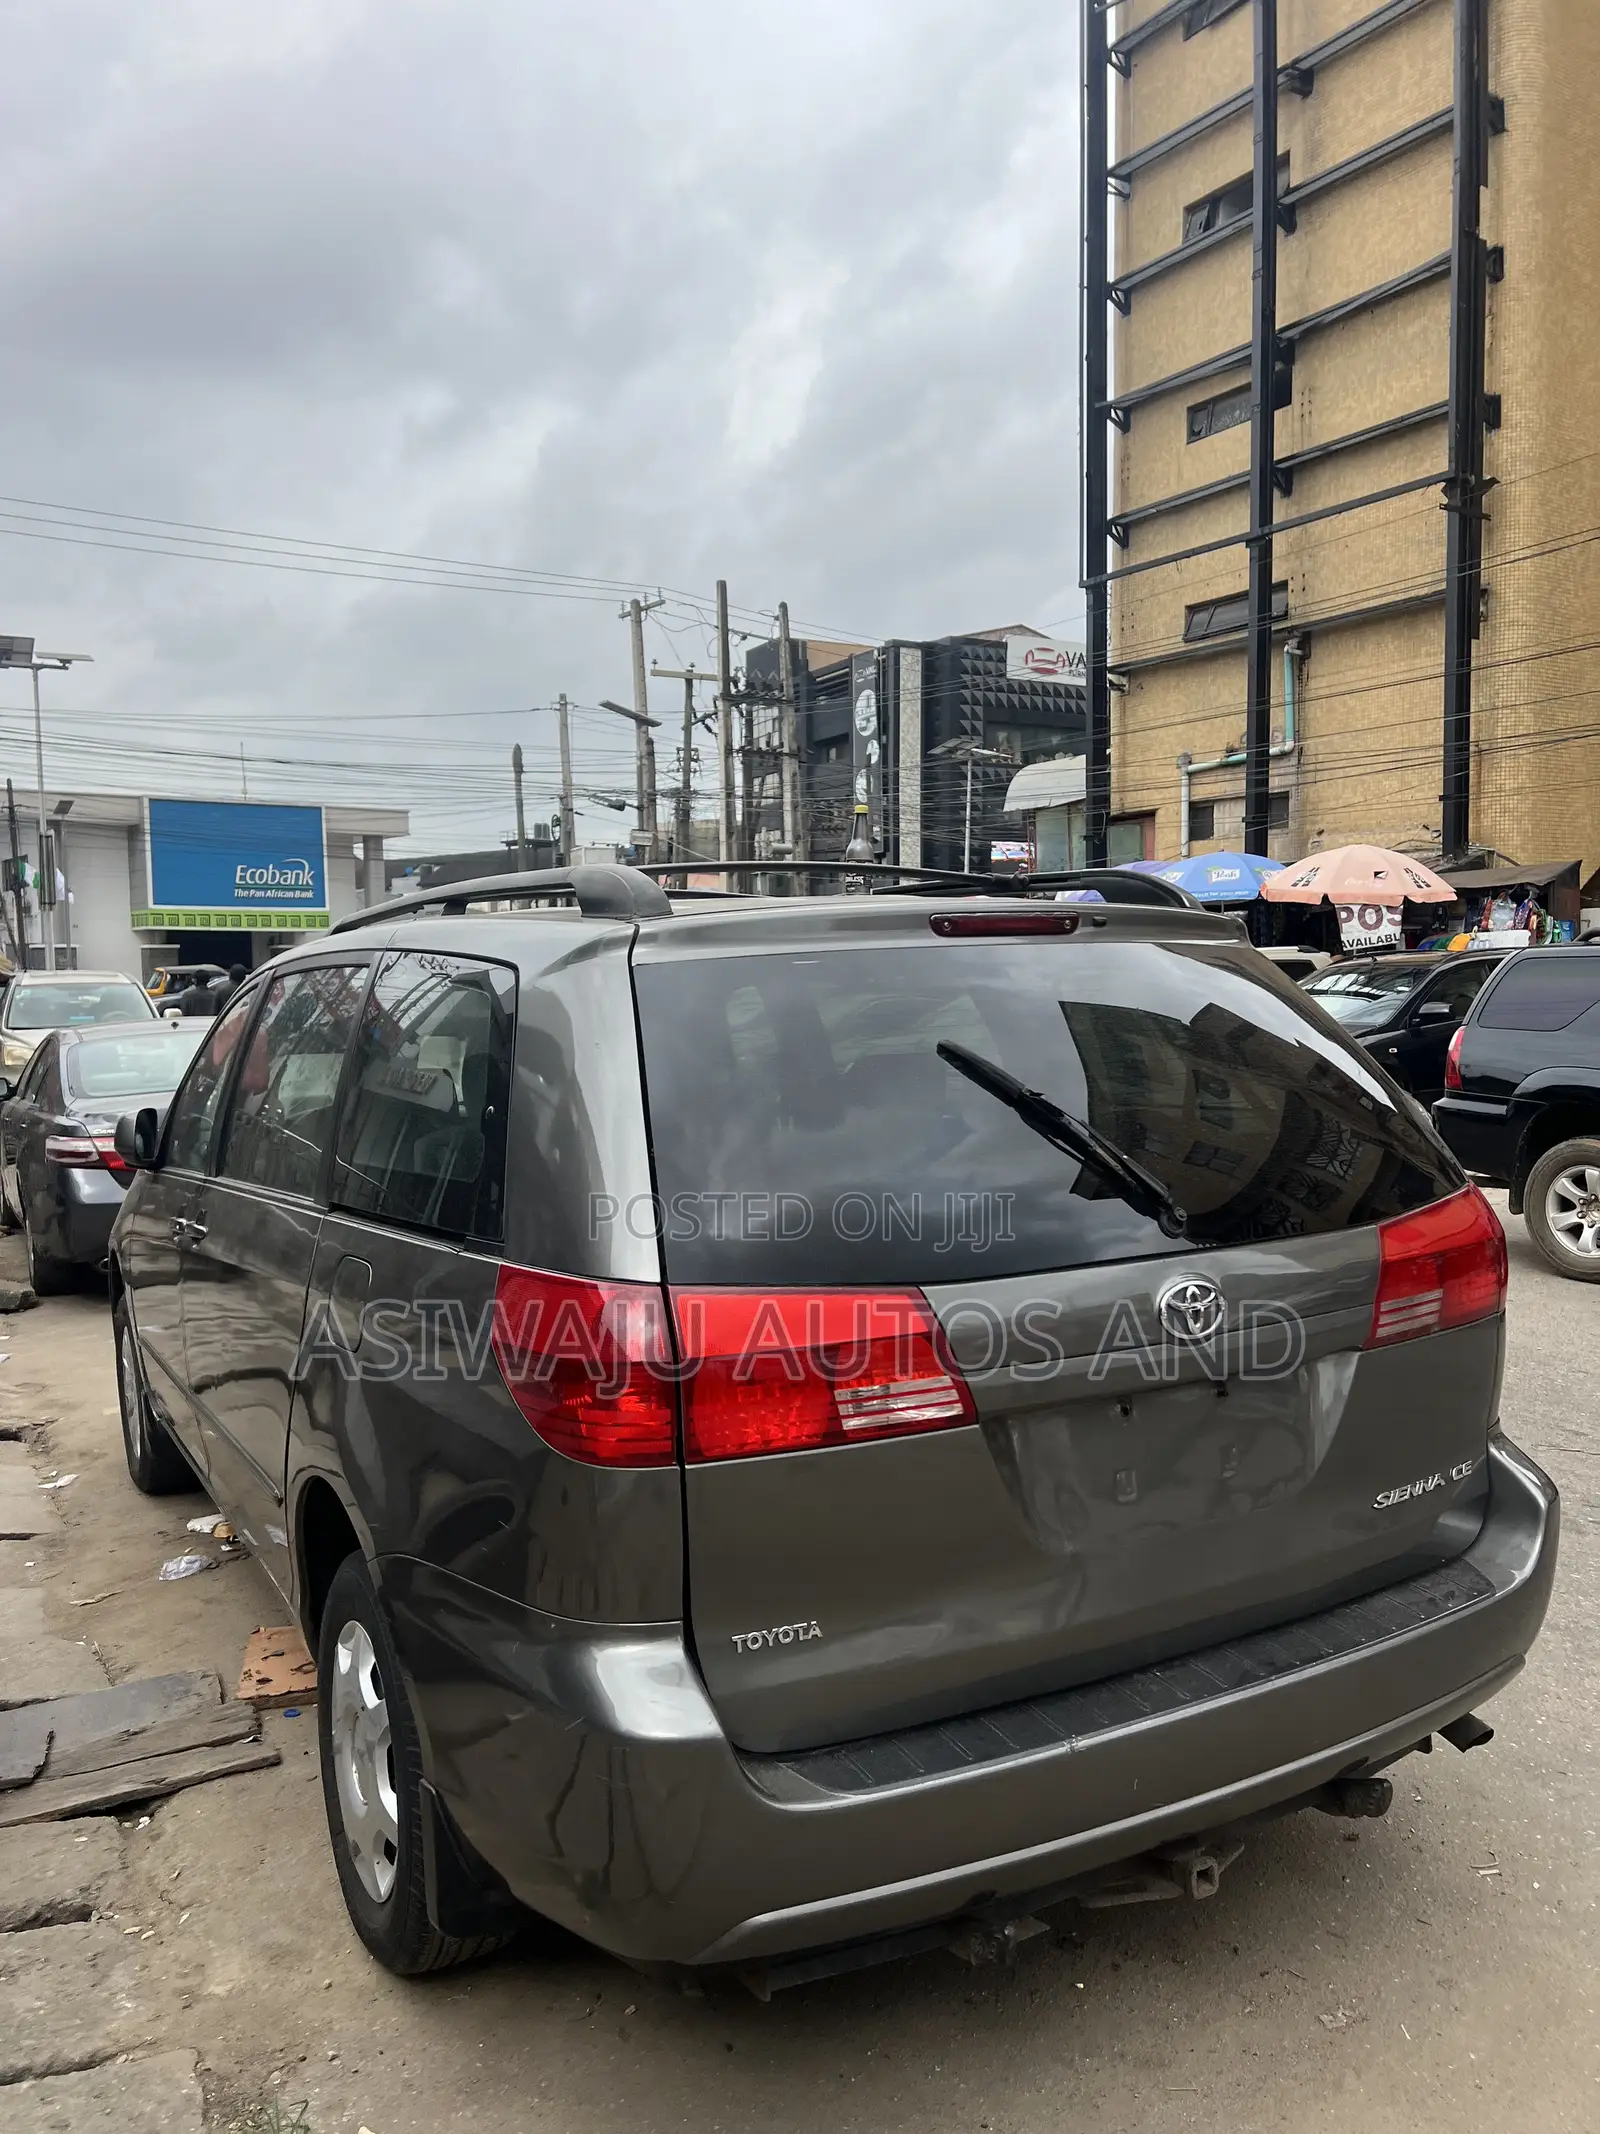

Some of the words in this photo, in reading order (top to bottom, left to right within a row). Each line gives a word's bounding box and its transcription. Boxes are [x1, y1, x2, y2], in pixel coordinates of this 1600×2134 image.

[235, 858, 315, 886] Ecobank
[234, 888, 249, 898] The
[249, 889, 265, 898] Pan
[265, 889, 294, 899] African
[294, 889, 315, 899] Bank
[1372, 1472, 1446, 1509] SIENNA
[1451, 1460, 1473, 1481] CE
[731, 1620, 823, 1654] TOYOTA
